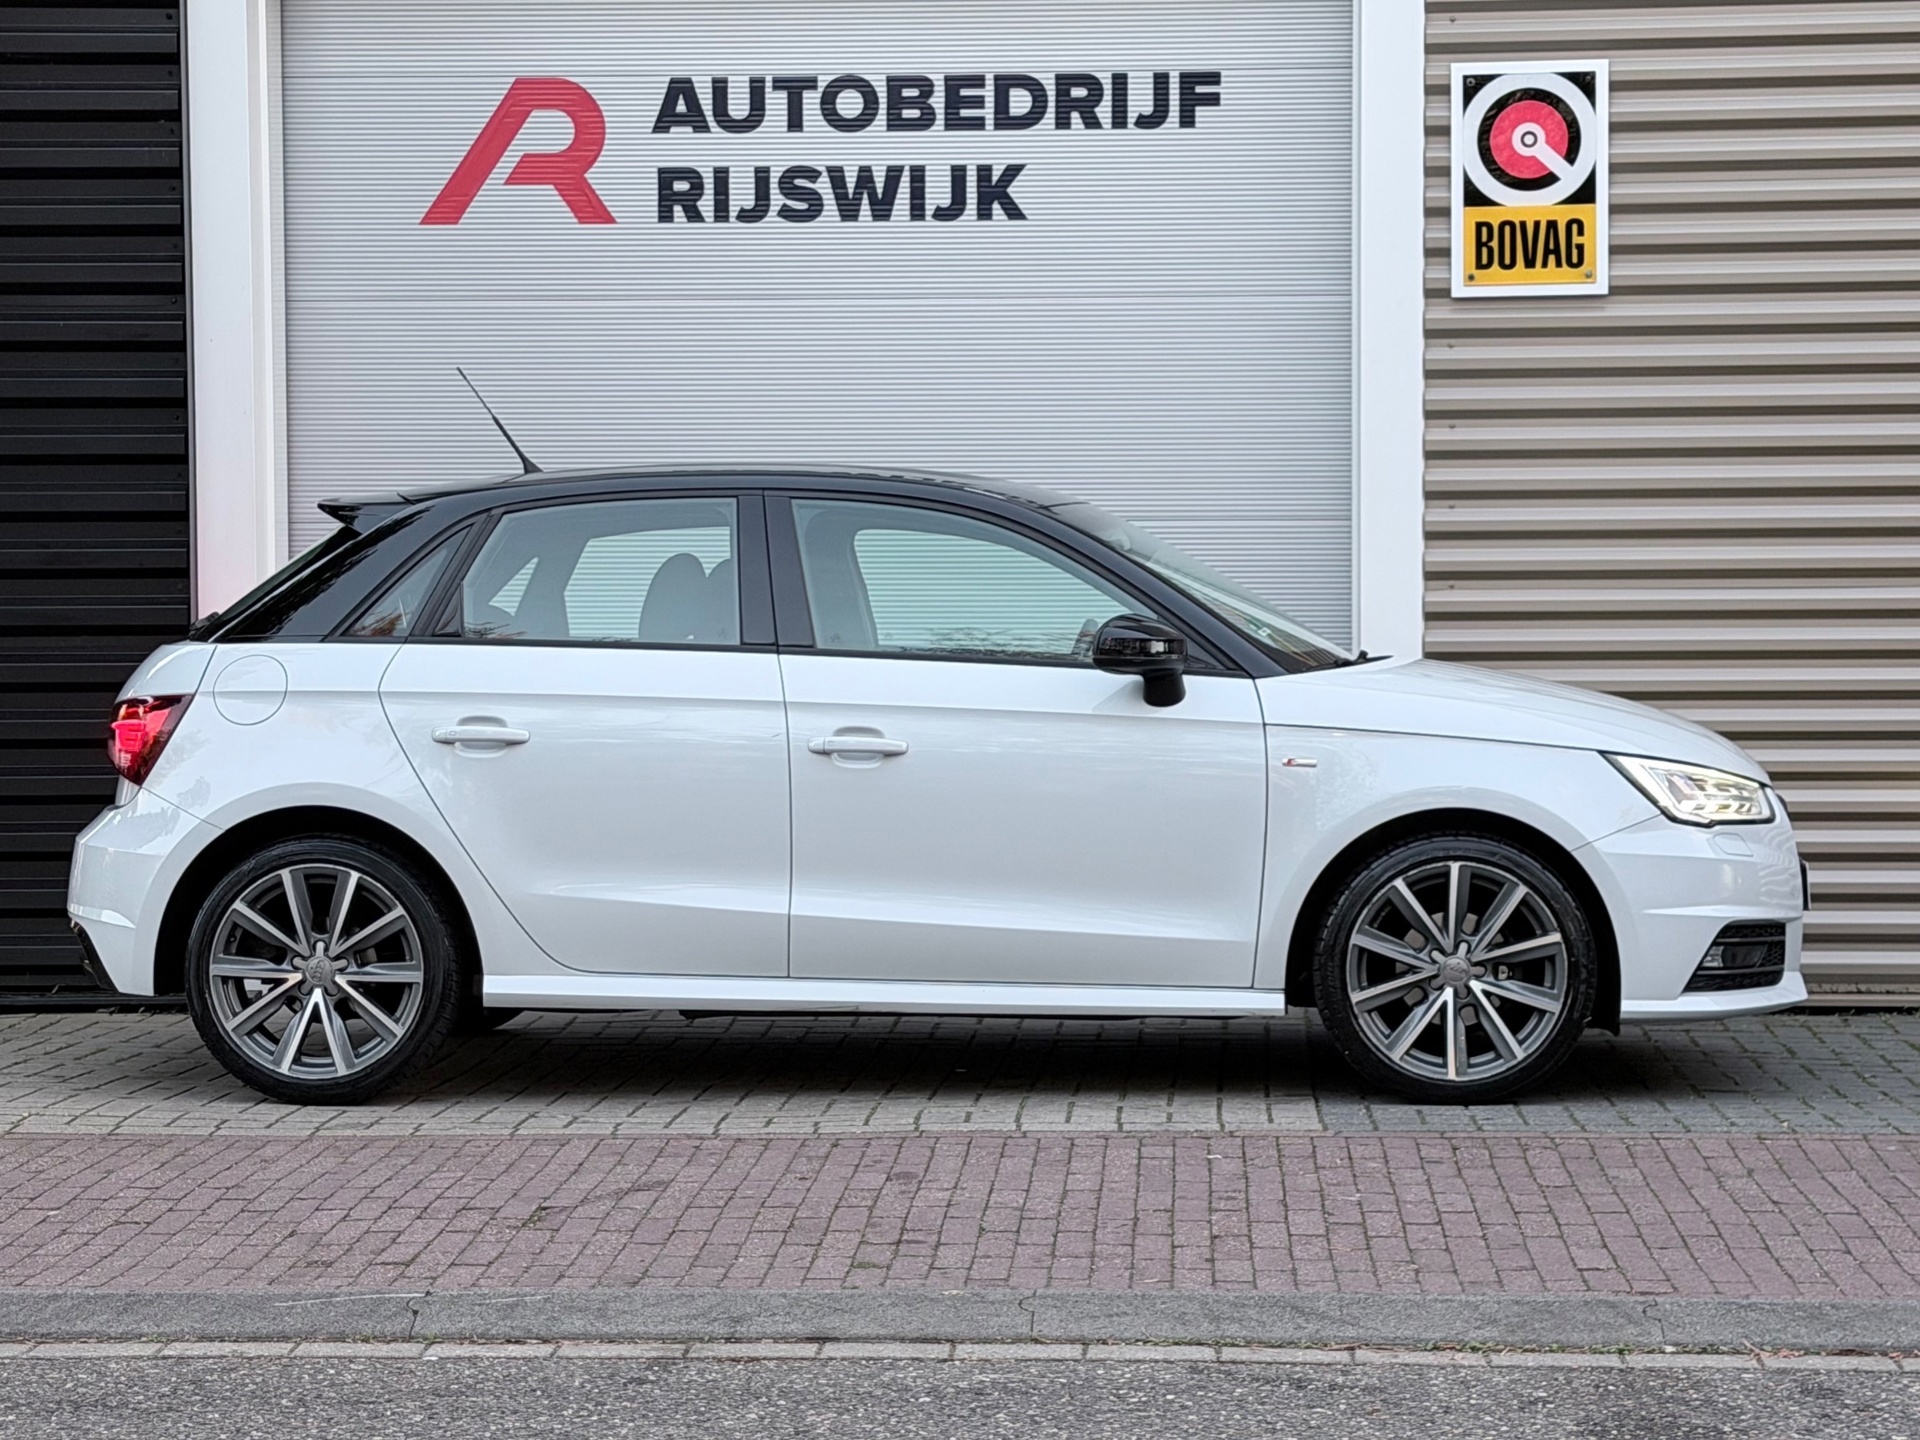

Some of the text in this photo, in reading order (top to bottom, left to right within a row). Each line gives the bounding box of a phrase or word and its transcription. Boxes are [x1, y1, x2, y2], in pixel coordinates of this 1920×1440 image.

[652, 71, 1221, 134] AUTOBEDRIJF
[657, 164, 1028, 223] RIJSWIJK
[1474, 218, 1585, 271] BOVAG
